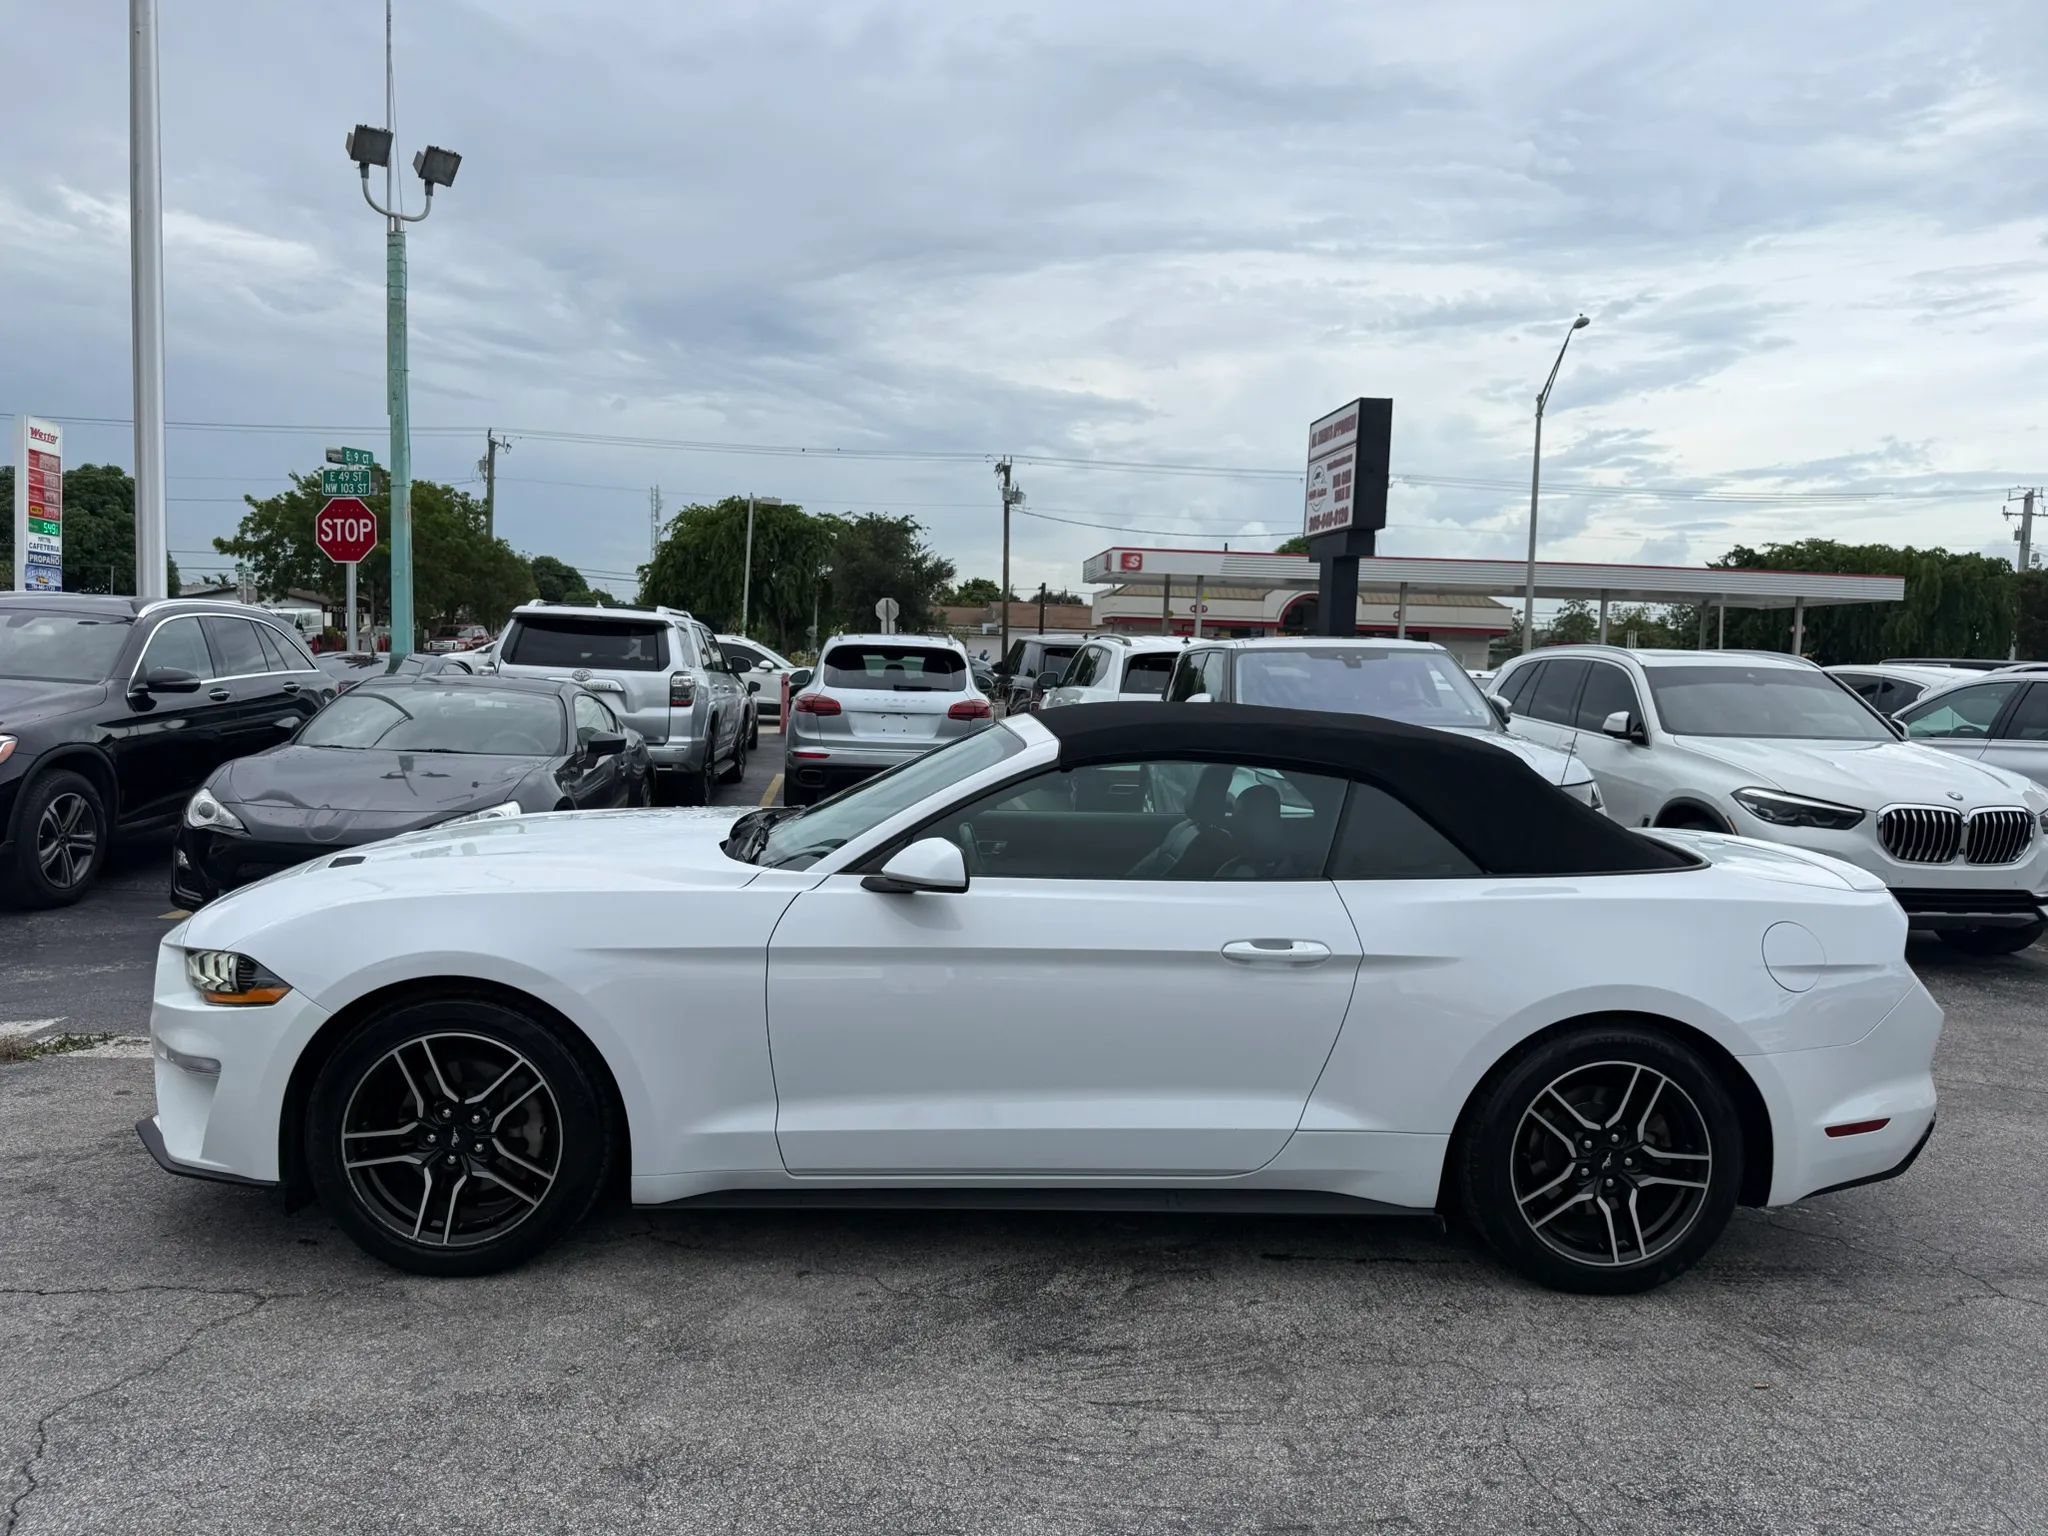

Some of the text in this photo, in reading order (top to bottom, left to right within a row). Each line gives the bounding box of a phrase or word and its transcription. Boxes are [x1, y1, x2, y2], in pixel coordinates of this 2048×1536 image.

[30, 426, 59, 445] Westar
[346, 451, 351, 461] E
[354, 452, 359, 462] 9
[362, 454, 369, 464] CT
[330, 471, 363, 482] E 49 ST
[324, 483, 368, 493] NW 103 ST
[321, 518, 372, 542] STOP
[28, 542, 60, 552] CAFETERIA
[327, 605, 367, 614] PROPNE
